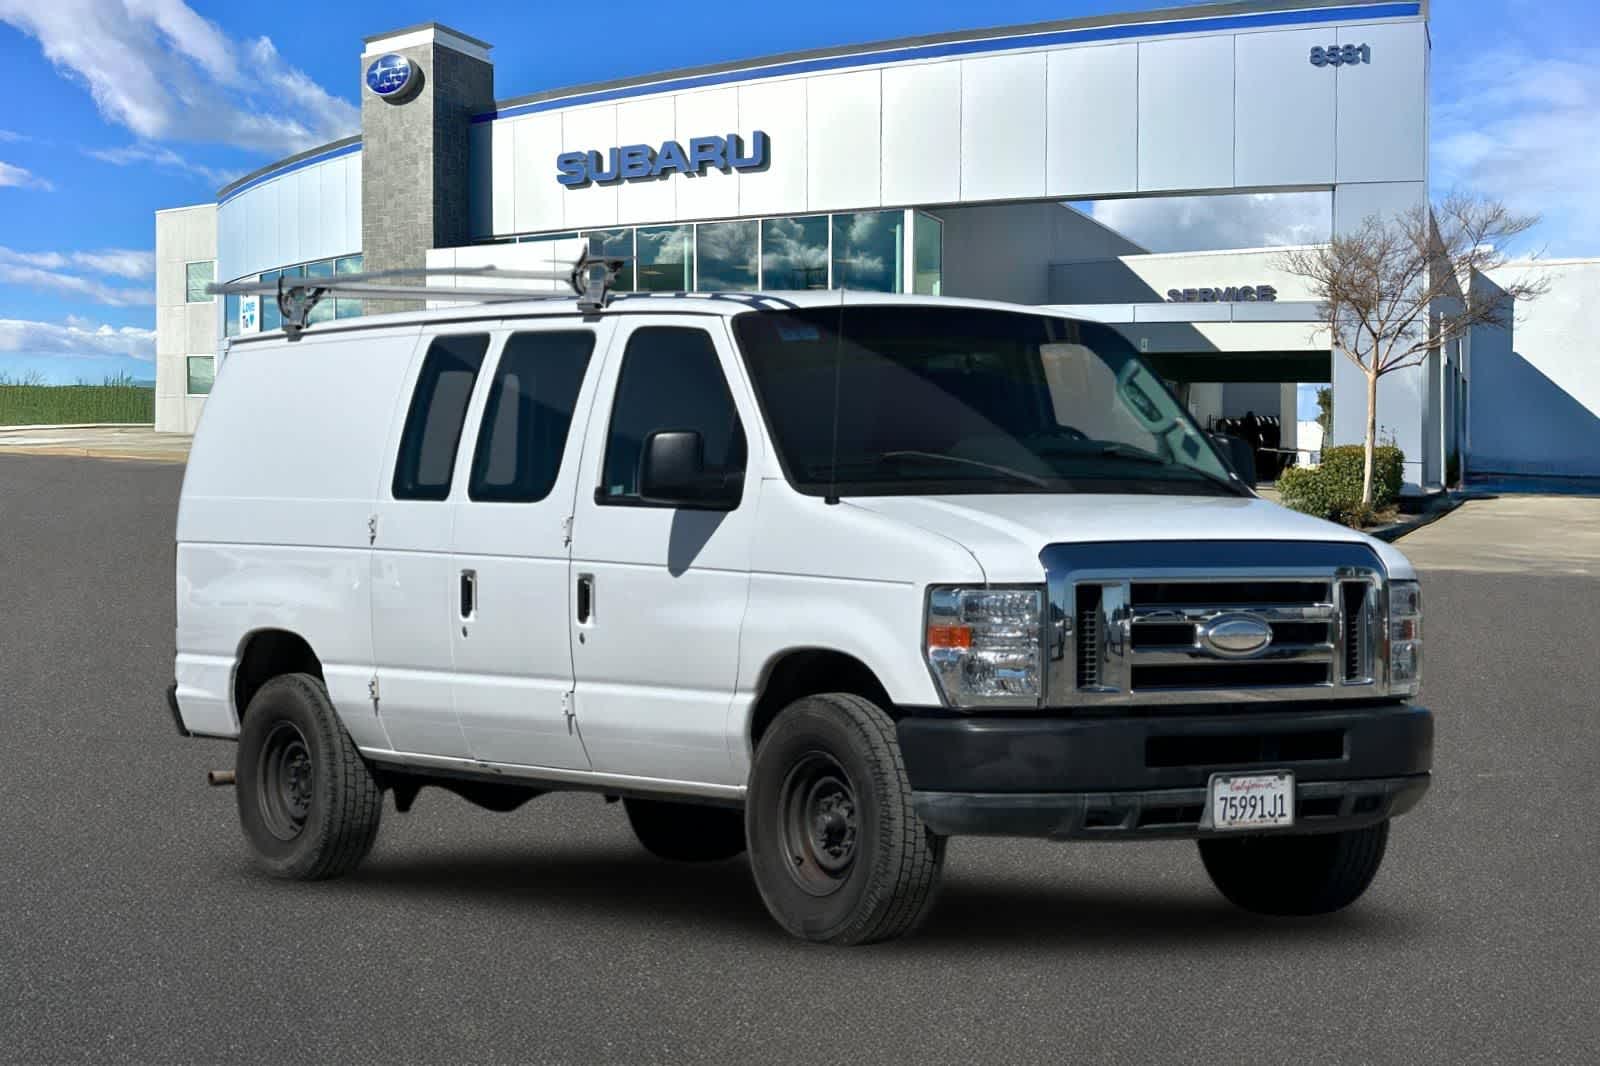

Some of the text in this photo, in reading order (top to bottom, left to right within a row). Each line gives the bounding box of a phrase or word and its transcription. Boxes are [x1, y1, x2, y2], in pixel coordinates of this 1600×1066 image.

[556, 129, 771, 190] SUBARU
[1166, 284, 1277, 303] SERVICE
[1219, 793, 1287, 821] 75991J1
